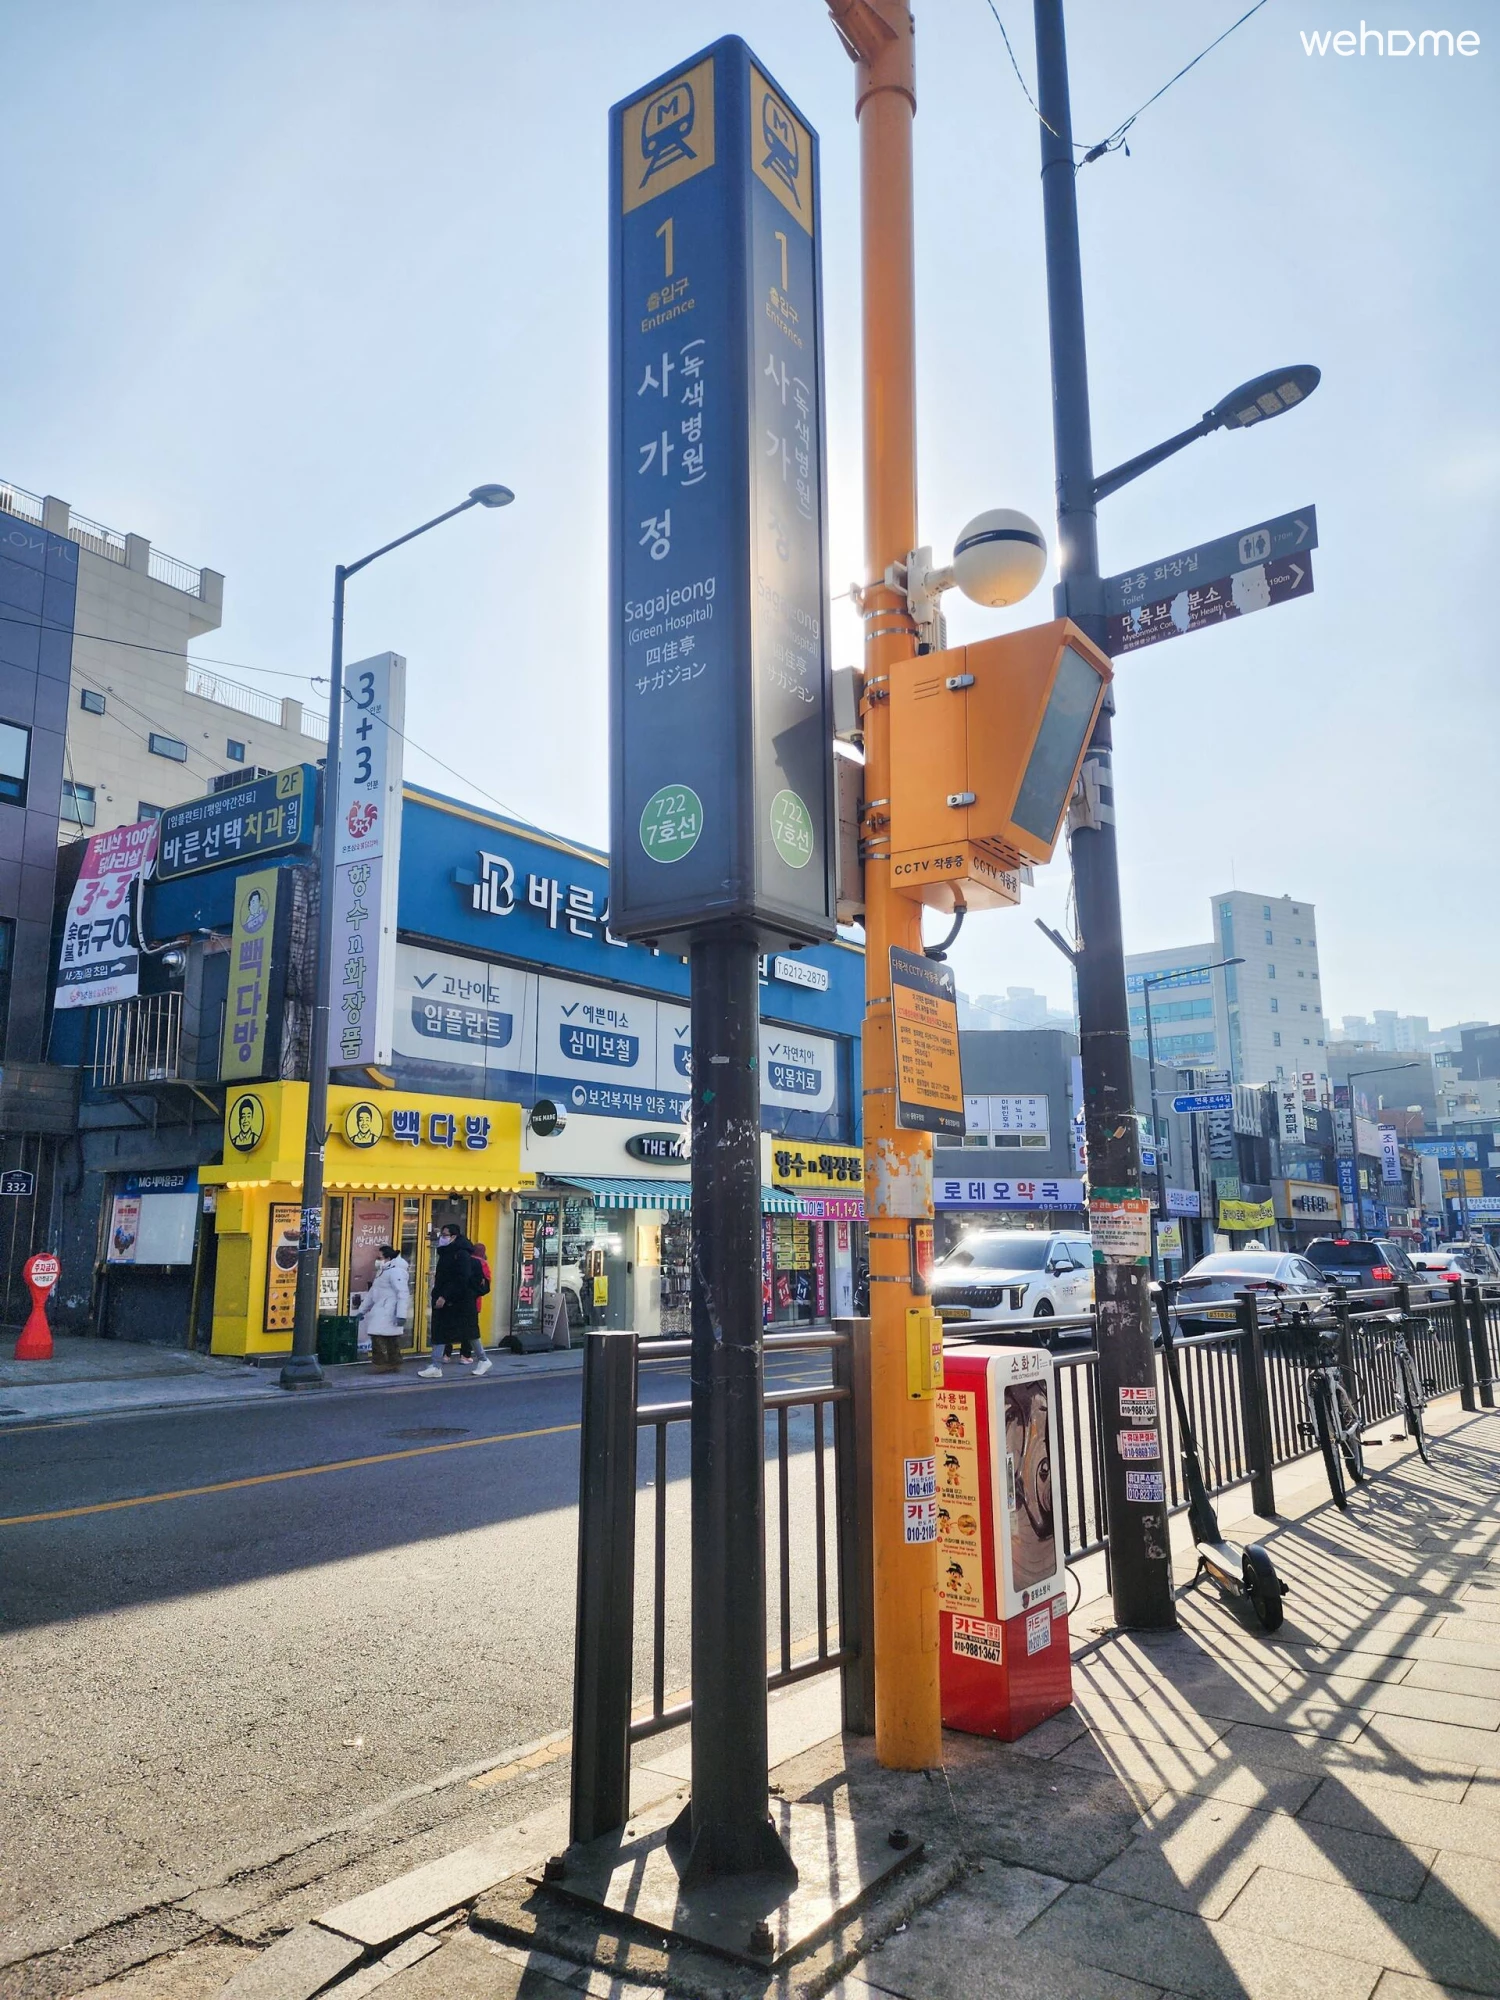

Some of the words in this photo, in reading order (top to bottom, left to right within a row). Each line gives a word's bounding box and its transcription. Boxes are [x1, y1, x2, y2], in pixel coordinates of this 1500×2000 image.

[655, 217, 674, 278] 1
[775, 231, 788, 292] 1
[646, 277, 689, 313] 출입구
[769, 287, 799, 324] 출입구
[641, 298, 695, 333] Entrance
[765, 302, 803, 349] Entrance
[680, 339, 706, 486] (녹색병원)
[637, 352, 675, 560] 사가정
[1120, 573, 1149, 594] 공중
[1153, 553, 1198, 581] 화장실
[624, 577, 716, 623] Sagajeong
[758, 576, 820, 640] Sageong
[1121, 593, 1145, 606] Toilet
[1121, 587, 1222, 633] 목보분소
[1269, 574, 1290, 586] 190m
[628, 624, 663, 645] (Green
[665, 603, 713, 632] Hospital)
[646, 635, 695, 667] 四佳亭
[357, 672, 374, 709] 3
[635, 662, 707, 695] サガジョン
[354, 746, 372, 784] 3
[281, 771, 299, 794] 2F
[655, 794, 686, 818] 722
[781, 798, 803, 824] 722
[350, 817, 370, 834] 3+3
[646, 813, 696, 846] 7호선
[775, 819, 809, 853] 7호선
[895, 860, 929, 875] CCTV
[934, 854, 964, 870] 작동중
[974, 857, 997, 879] CCTV
[999, 870, 1018, 893] 작동중
[778, 961, 827, 987] T.6212-2879
[909, 965, 923, 977] CCTV
[233, 937, 264, 1063] 빽다방
[442, 976, 500, 1004] 고난이도
[424, 1005, 501, 1039] 임플란트
[583, 1005, 629, 1028] 예쁜미소
[569, 1030, 630, 1062] 심미보철
[783, 1045, 815, 1064] 자연치아
[774, 1066, 816, 1090] 잇몸치료
[543, 1113, 557, 1121] MADE
[589, 1090, 643, 1112] 보건복지부
[646, 1096, 666, 1114] 인증
[1015, 1099, 1023, 1128] 비뇨기과
[391, 1109, 491, 1151] 빽다방
[643, 1139, 666, 1156] THE
[1383, 1134, 1398, 1179] 조이골드
[775, 1150, 863, 1182] 향수n화장품
[6, 1183, 27, 1192] 332
[944, 1182, 1060, 1201] 로데오약국
[1011, 1353, 1039, 1373] 소화기
[936, 1402, 948, 1410] How
[938, 1393, 967, 1404] 사용법
[1121, 1389, 1147, 1400] 카드
[909, 1461, 934, 1476] 카드
[908, 1503, 935, 1519] 카드
[956, 1617, 986, 1637] 카드
[1028, 1617, 1040, 1631] 카드
